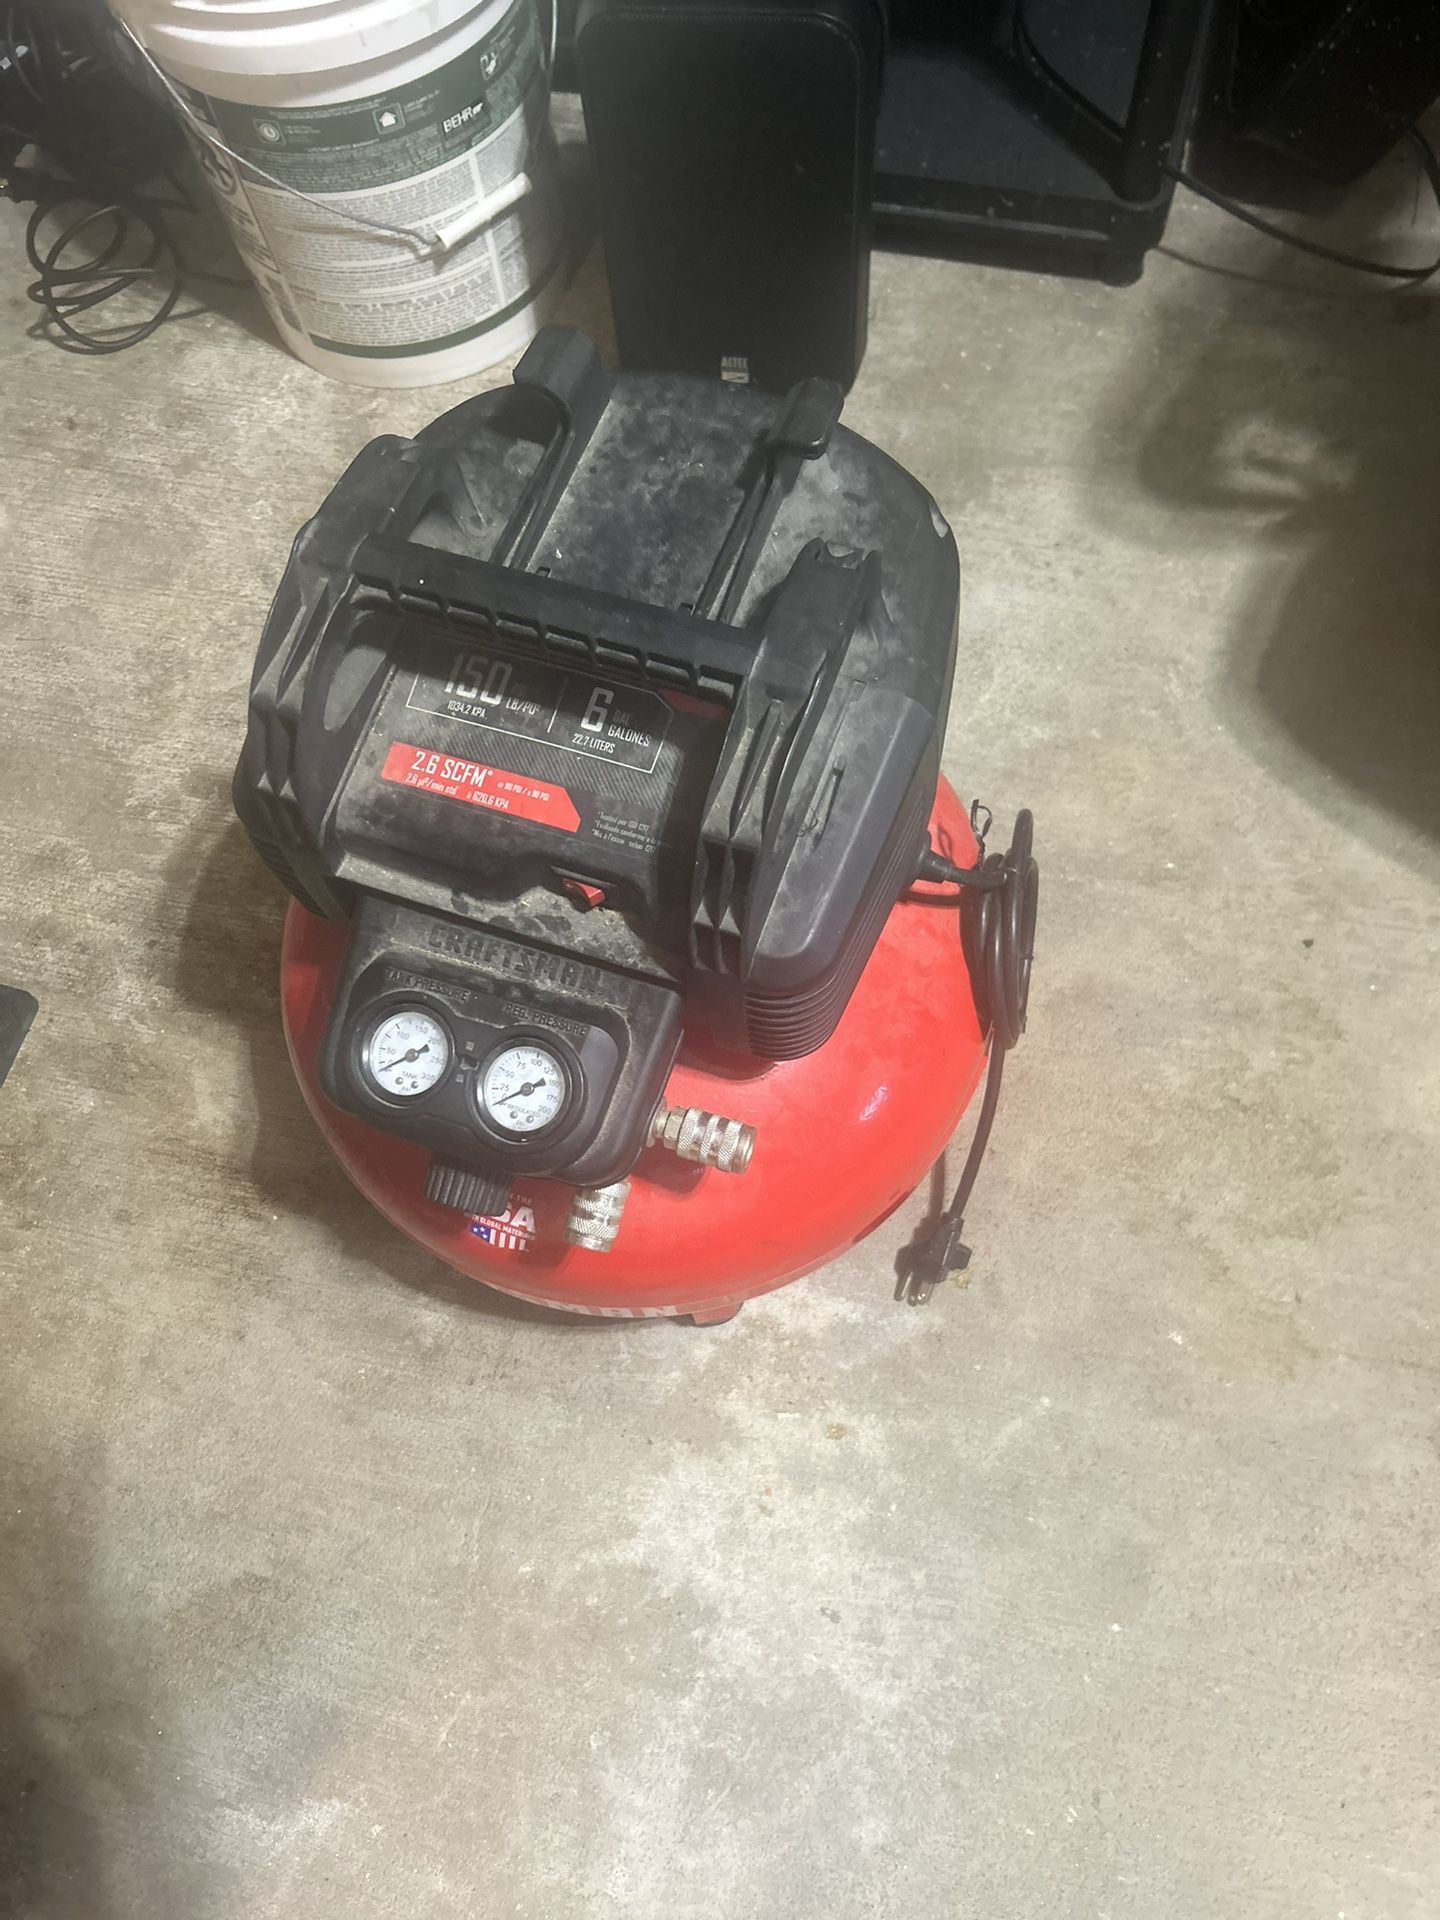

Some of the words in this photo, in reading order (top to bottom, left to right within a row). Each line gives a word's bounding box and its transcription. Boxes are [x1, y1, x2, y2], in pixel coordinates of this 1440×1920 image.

[443, 106, 474, 133] BEHR
[444, 652, 513, 705] 150
[447, 700, 471, 715] 1034.2
[471, 706, 486, 718] KPA
[581, 687, 614, 732] 6
[572, 733, 589, 746] 22.7
[589, 738, 616, 753] LITERS
[608, 724, 651, 747] GALONES
[411, 751, 440, 774] 2.6
[405, 772, 418, 784] 2.6
[472, 790, 495, 805] 620.6
[494, 797, 510, 809] KPA
[429, 923, 602, 992] CRAFTSMAN
[415, 977, 471, 1002] PRESSURE
[504, 1003, 530, 1021] REG.
[532, 1011, 588, 1036] PRESSURE
[516, 1060, 527, 1070] 75
[530, 1058, 543, 1067] 100
[543, 1066, 555, 1076] 125
[505, 1070, 515, 1079] 50
[500, 1083, 510, 1092] 25
[479, 1217, 501, 1230] GLOBAL
